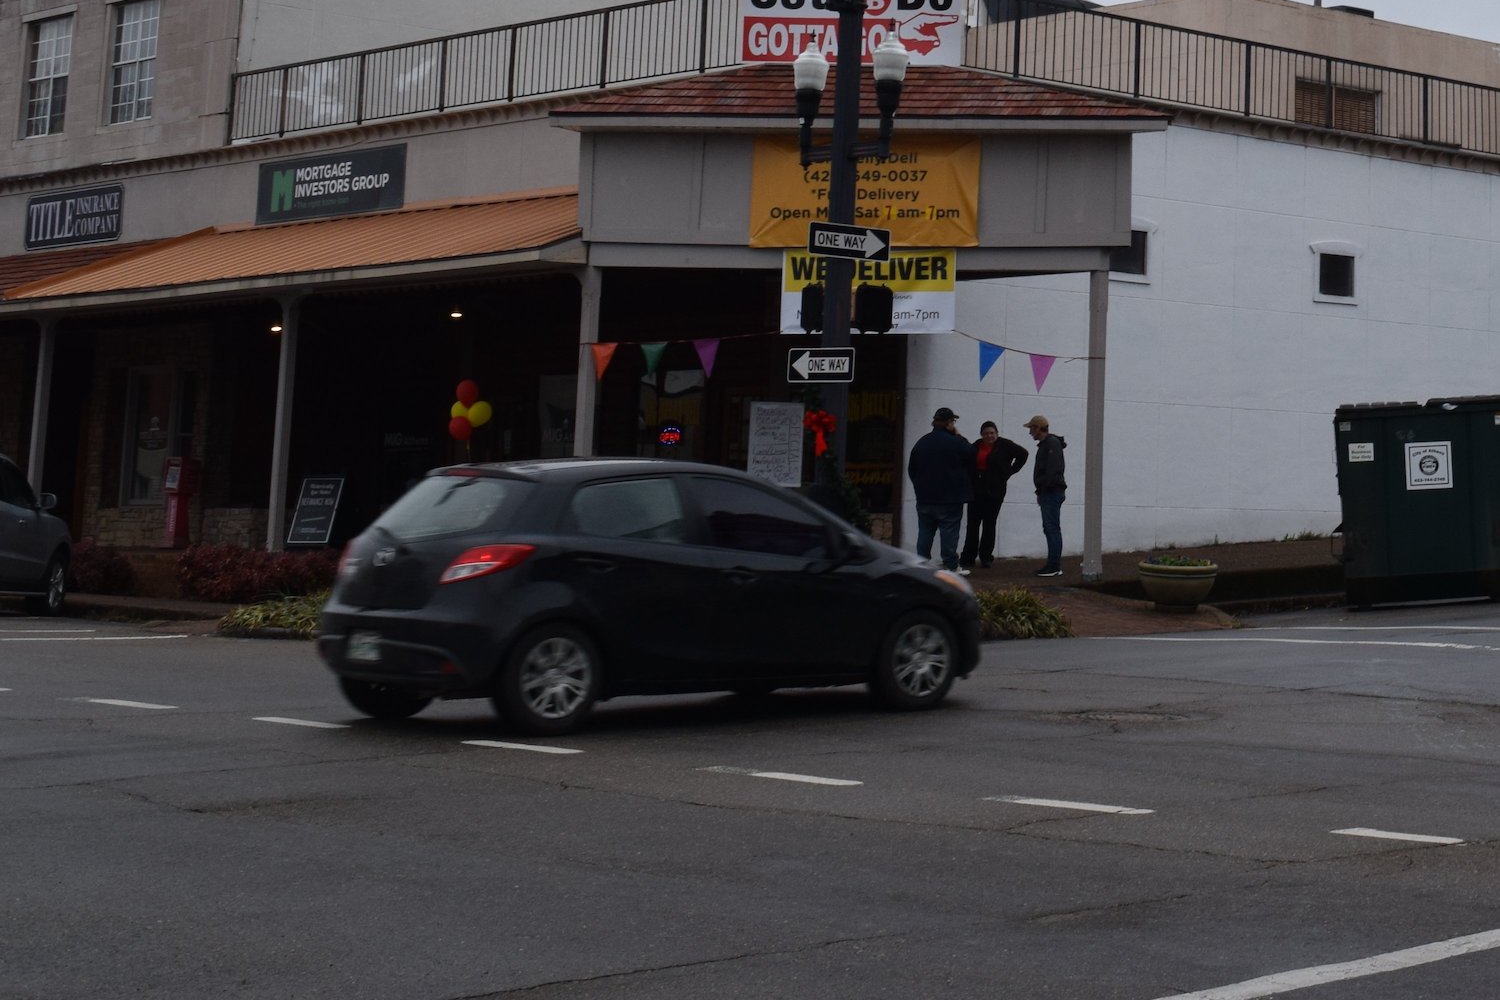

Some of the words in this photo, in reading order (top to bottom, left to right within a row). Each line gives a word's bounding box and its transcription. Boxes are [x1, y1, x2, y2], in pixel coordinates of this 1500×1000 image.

[295, 161, 352, 182] MORTGAGE
[294, 178, 350, 199] INVESTORS
[351, 173, 390, 192] GROUP
[857, 188, 919, 202] Delivery
[76, 192, 119, 215] INSURANCE
[770, 207, 810, 221] Open
[29, 199, 76, 242] TITLE
[74, 214, 119, 237] COMPANY
[818, 233, 839, 246] ONE
[844, 236, 866, 249] WAY
[808, 359, 826, 371] ONE
[828, 359, 847, 371] WAY
